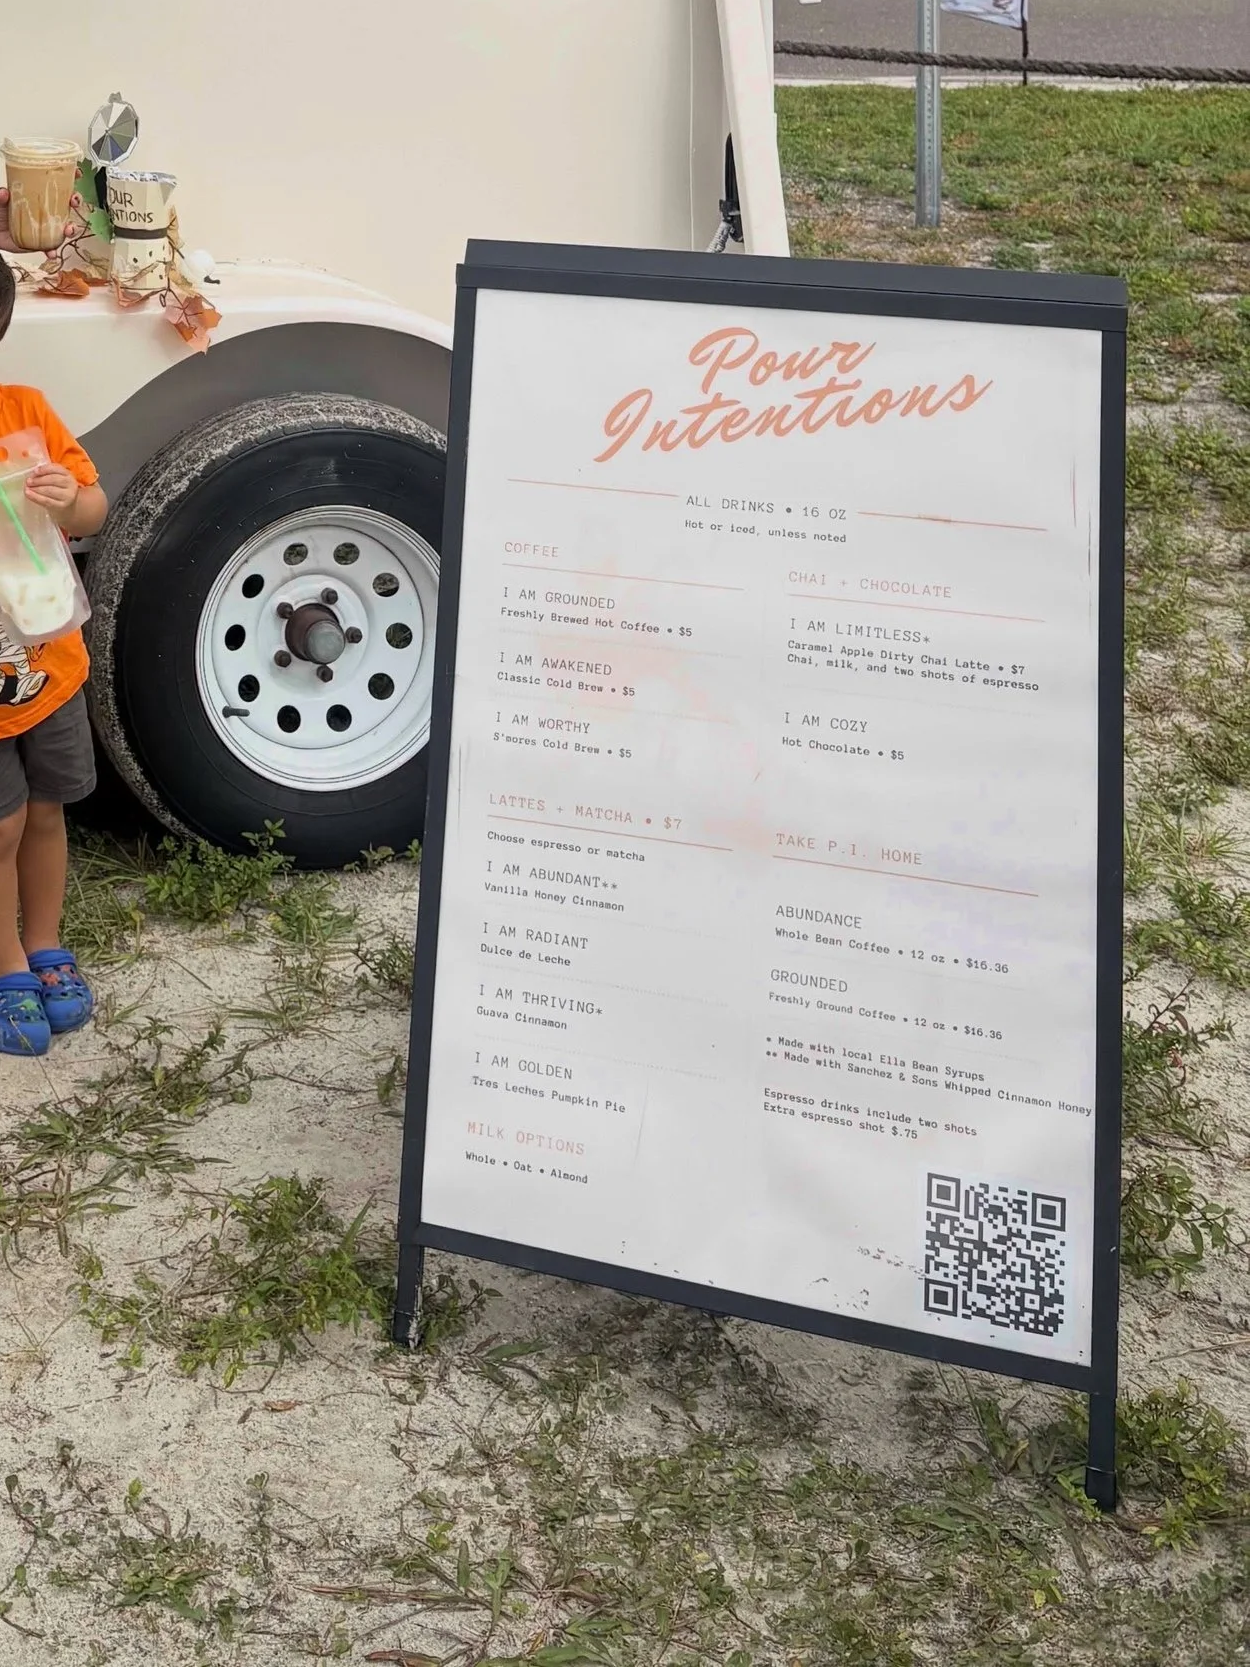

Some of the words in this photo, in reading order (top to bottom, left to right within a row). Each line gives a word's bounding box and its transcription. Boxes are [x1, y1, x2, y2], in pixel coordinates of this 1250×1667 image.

[108, 187, 134, 208] OUR
[109, 209, 154, 223] NTIONS
[688, 327, 877, 394] Pour
[593, 374, 993, 462] Intentions
[686, 495, 711, 508] ALL
[721, 498, 774, 514] DRINKS
[802, 506, 820, 518] 16
[828, 508, 847, 521] OZ
[684, 519, 704, 530] Hot
[710, 523, 723, 531] or
[730, 523, 760, 537] iced,
[768, 528, 807, 540] unless
[813, 533, 847, 543] noted
[504, 541, 559, 558] COFFEE
[503, 586, 509, 598] I
[518, 589, 536, 601] AM
[545, 591, 615, 610] GROUNDED
[788, 570, 826, 586] CHAI
[859, 578, 952, 599] CHOCOLATE
[500, 606, 545, 622] Freshly
[550, 612, 589, 626] Brewed
[595, 617, 614, 628] Hot
[620, 620, 660, 634] Coffee
[678, 626, 693, 637] $5
[789, 617, 797, 630] I
[807, 620, 825, 633] AM
[499, 651, 506, 663] I
[514, 654, 532, 666] AM
[541, 657, 612, 676] AWAKENED
[787, 639, 833, 653] Caramel
[840, 645, 874, 658] Apple
[880, 649, 914, 665] Dirty
[920, 654, 947, 667] Chai
[954, 658, 990, 671] Latte
[1010, 664, 1025, 675] $7
[497, 671, 541, 685] Classic
[546, 677, 572, 689] Cold
[577, 681, 604, 693] Brew
[622, 685, 635, 697] $5
[787, 653, 818, 668] Chai,
[826, 659, 858, 672] milk,
[866, 664, 887, 673] and
[894, 665, 915, 677] two
[920, 669, 955, 682] shots
[961, 673, 976, 684] of
[982, 677, 1039, 691] espresso
[495, 711, 502, 723] I
[511, 714, 529, 726] AM
[538, 717, 591, 734] WORTHY
[784, 711, 791, 724] I
[801, 714, 820, 727] AM
[830, 717, 868, 733] COZY
[493, 731, 537, 746] S'mores
[542, 738, 569, 750] Cold
[574, 742, 600, 755] Brew
[619, 748, 632, 759] $5
[782, 736, 802, 748] Hot
[808, 739, 870, 756] Chocolate
[890, 749, 905, 761] $5
[489, 793, 546, 812] LATTES
[575, 805, 633, 824] MATCHA
[663, 815, 683, 830] $7
[487, 830, 525, 845] Choose
[530, 839, 582, 853] espresso
[587, 847, 601, 855] or
[606, 849, 645, 862] matcha
[776, 832, 816, 850] TAKE
[828, 839, 866, 858] P.I.
[881, 847, 922, 866] HOME
[486, 860, 493, 872] I
[502, 863, 520, 876] AM
[484, 881, 528, 897] Vanilla
[534, 889, 567, 905] Honey
[572, 895, 625, 912] Cinnamon
[775, 905, 862, 930] ABUNDANCE
[482, 921, 489, 934] I
[498, 925, 516, 938] AM
[526, 928, 589, 950] RADIANT
[774, 926, 809, 941] Whole
[815, 933, 842, 947] Bean
[848, 939, 891, 955] Coffee
[910, 949, 925, 960] 12
[930, 954, 946, 964] oz
[965, 957, 1009, 974] $16.36
[480, 943, 513, 957] Dulce
[518, 949, 532, 960] de
[538, 952, 571, 967] Leche
[478, 983, 485, 996] I
[495, 987, 513, 1001] AM
[770, 968, 848, 993] GROUNDED
[476, 1005, 509, 1020] Guava
[514, 1011, 568, 1030] Cinnamon
[768, 991, 811, 1009] Freshly
[816, 1000, 853, 1014] Ground
[858, 1007, 896, 1022] Coffee
[914, 1017, 927, 1027] 12
[932, 1022, 946, 1031] oz
[963, 1025, 1003, 1041] $16.36
[474, 1051, 482, 1063] I
[491, 1055, 509, 1069] AM
[518, 1059, 573, 1080] GOLDEN
[778, 1036, 804, 1049] Made
[809, 1043, 835, 1055] with
[842, 1047, 872, 1062] local
[879, 1054, 906, 1068] Ella
[912, 1060, 938, 1074] Bean
[944, 1065, 985, 1082] Syrups
[472, 1075, 499, 1089] Tres
[505, 1082, 545, 1098] Leches
[551, 1089, 599, 1108] Pumpkin
[605, 1100, 626, 1113] Pie
[784, 1051, 810, 1064] Made
[815, 1058, 841, 1070] with
[847, 1062, 893, 1080] Sanchez
[898, 1072, 906, 1082] &
[911, 1074, 939, 1088] Sons
[944, 1080, 991, 1097] Whipped
[997, 1089, 1052, 1108] Cinnamon
[1058, 1100, 1092, 1117] Honey
[763, 1101, 795, 1117] Extra
[801, 1111, 853, 1127] espresso
[859, 1121, 885, 1134] shot
[891, 1125, 918, 1140] $.75
[764, 1087, 815, 1106] Espresso
[820, 1098, 860, 1114] drinks
[866, 1107, 912, 1124] include
[918, 1116, 938, 1129] two
[944, 1122, 978, 1136] shots
[467, 1121, 504, 1140] MILK
[515, 1130, 585, 1156] OPTIONS
[465, 1150, 496, 1166] Whole
[513, 1160, 533, 1173] Oat
[550, 1168, 588, 1184] Almond
